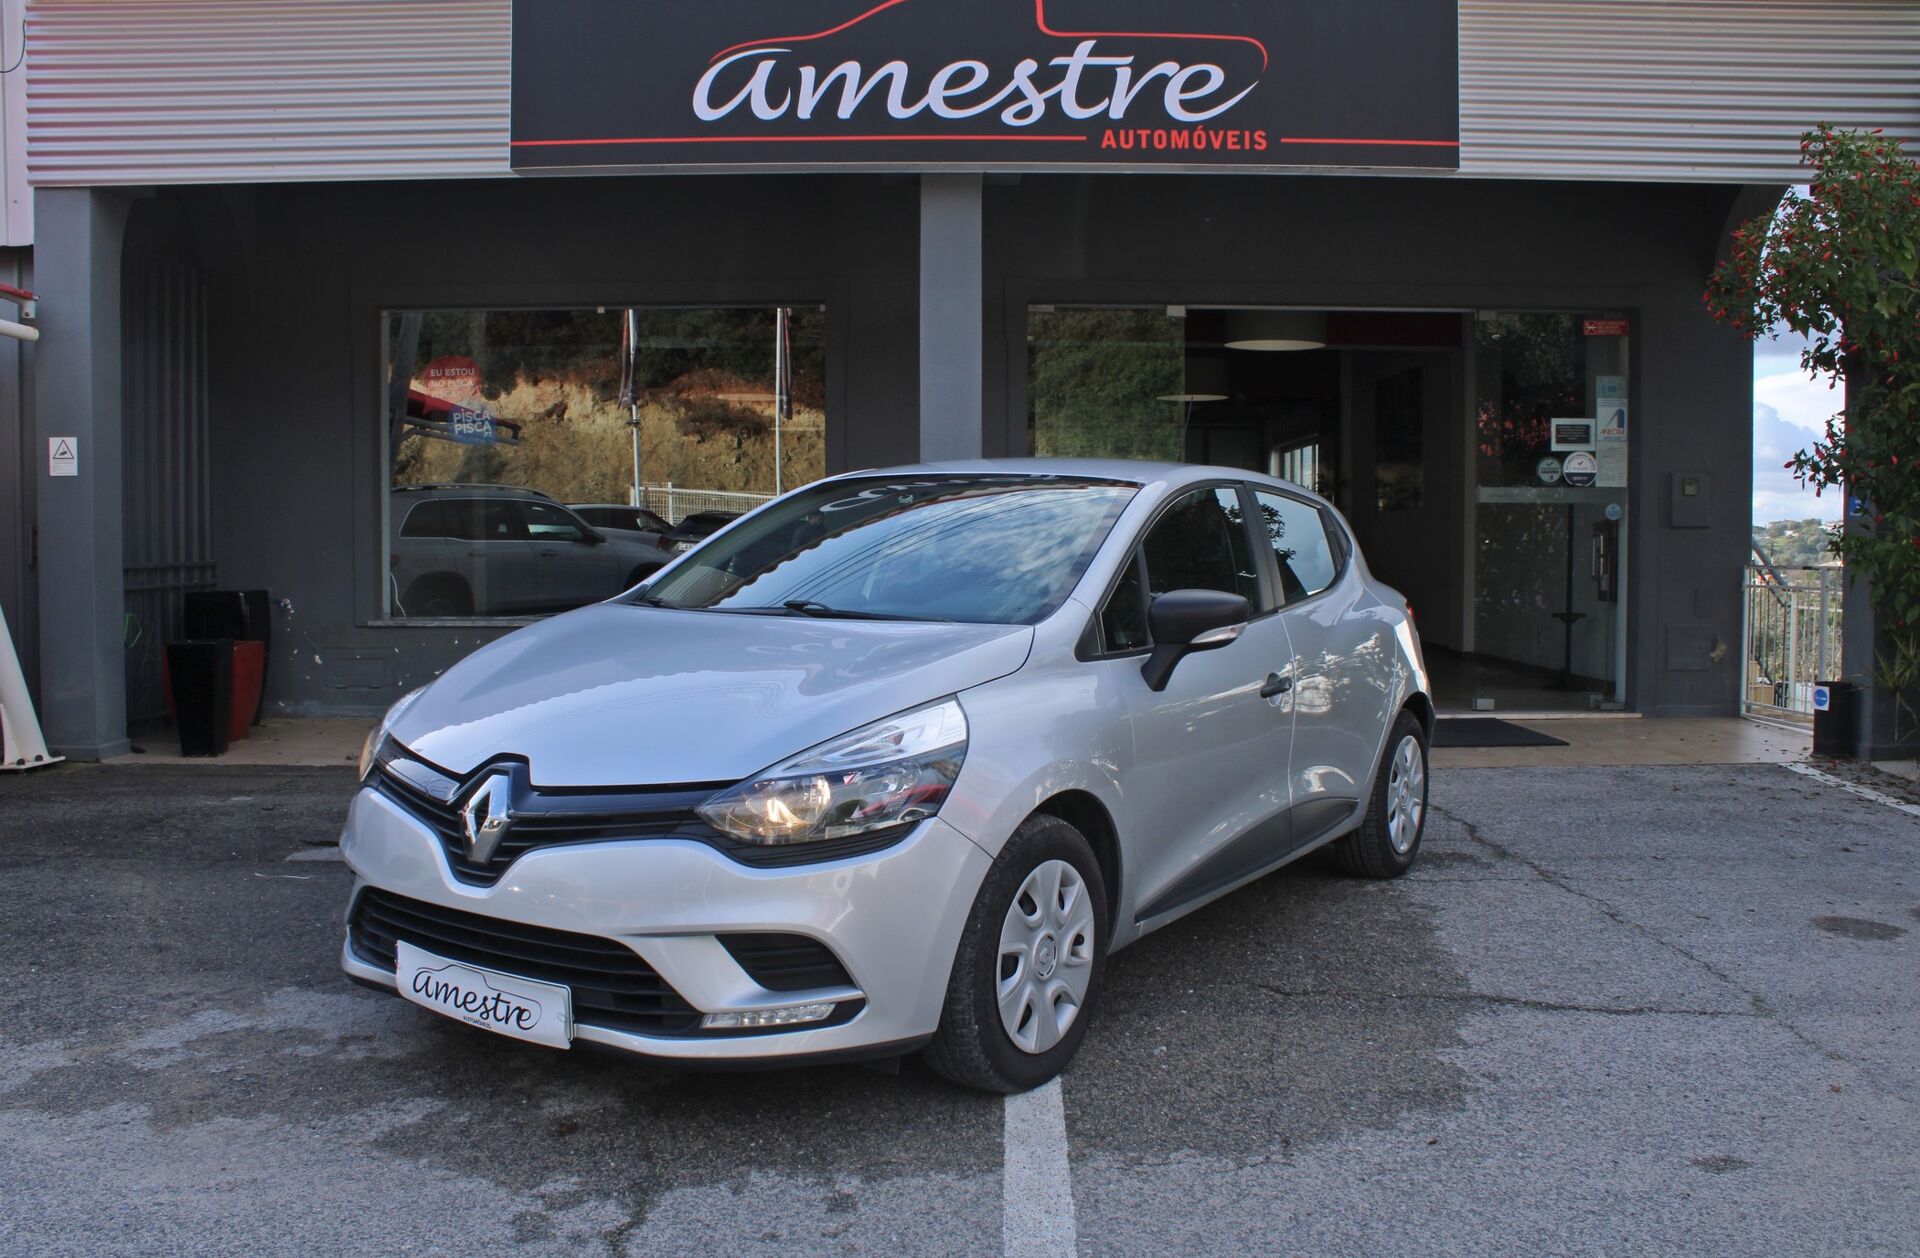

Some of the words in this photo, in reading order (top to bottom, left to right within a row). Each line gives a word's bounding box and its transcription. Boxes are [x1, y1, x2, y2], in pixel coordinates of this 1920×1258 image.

[692, 40, 1260, 127] amestre
[1101, 125, 1267, 150] AUTOMÓVEIS
[430, 368, 443, 377] EU
[445, 368, 475, 376] ESTOU
[454, 421, 493, 435] PISCA
[413, 970, 532, 1030] amestre
